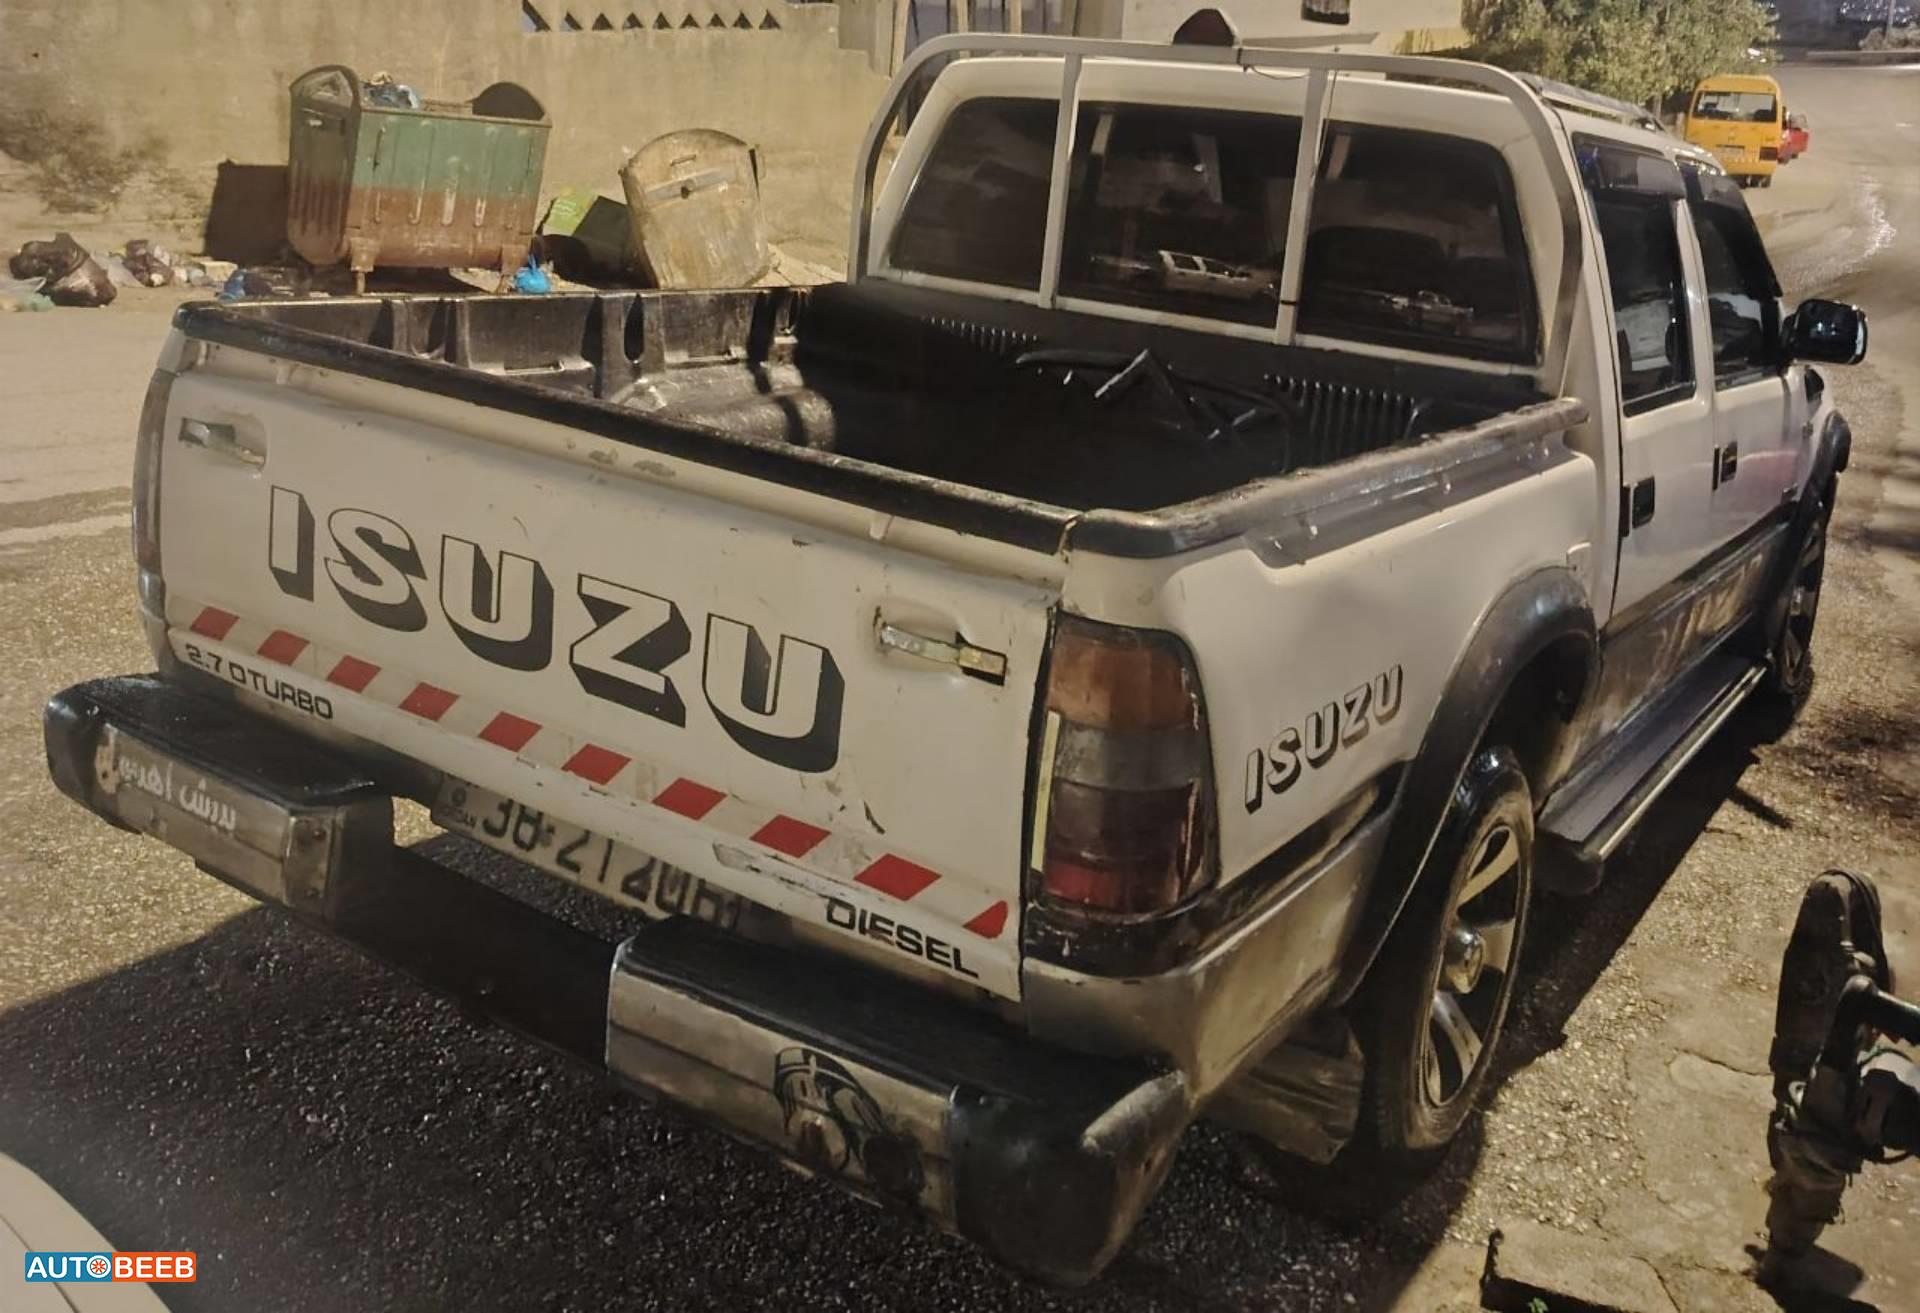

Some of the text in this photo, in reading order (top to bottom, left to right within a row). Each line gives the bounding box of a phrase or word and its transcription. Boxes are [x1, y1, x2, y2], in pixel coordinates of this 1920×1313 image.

[185, 643, 223, 673] 2.7
[269, 485, 846, 773] ISUZU
[1245, 664, 1403, 815] ISUZU
[826, 897, 979, 979] DIESEL
